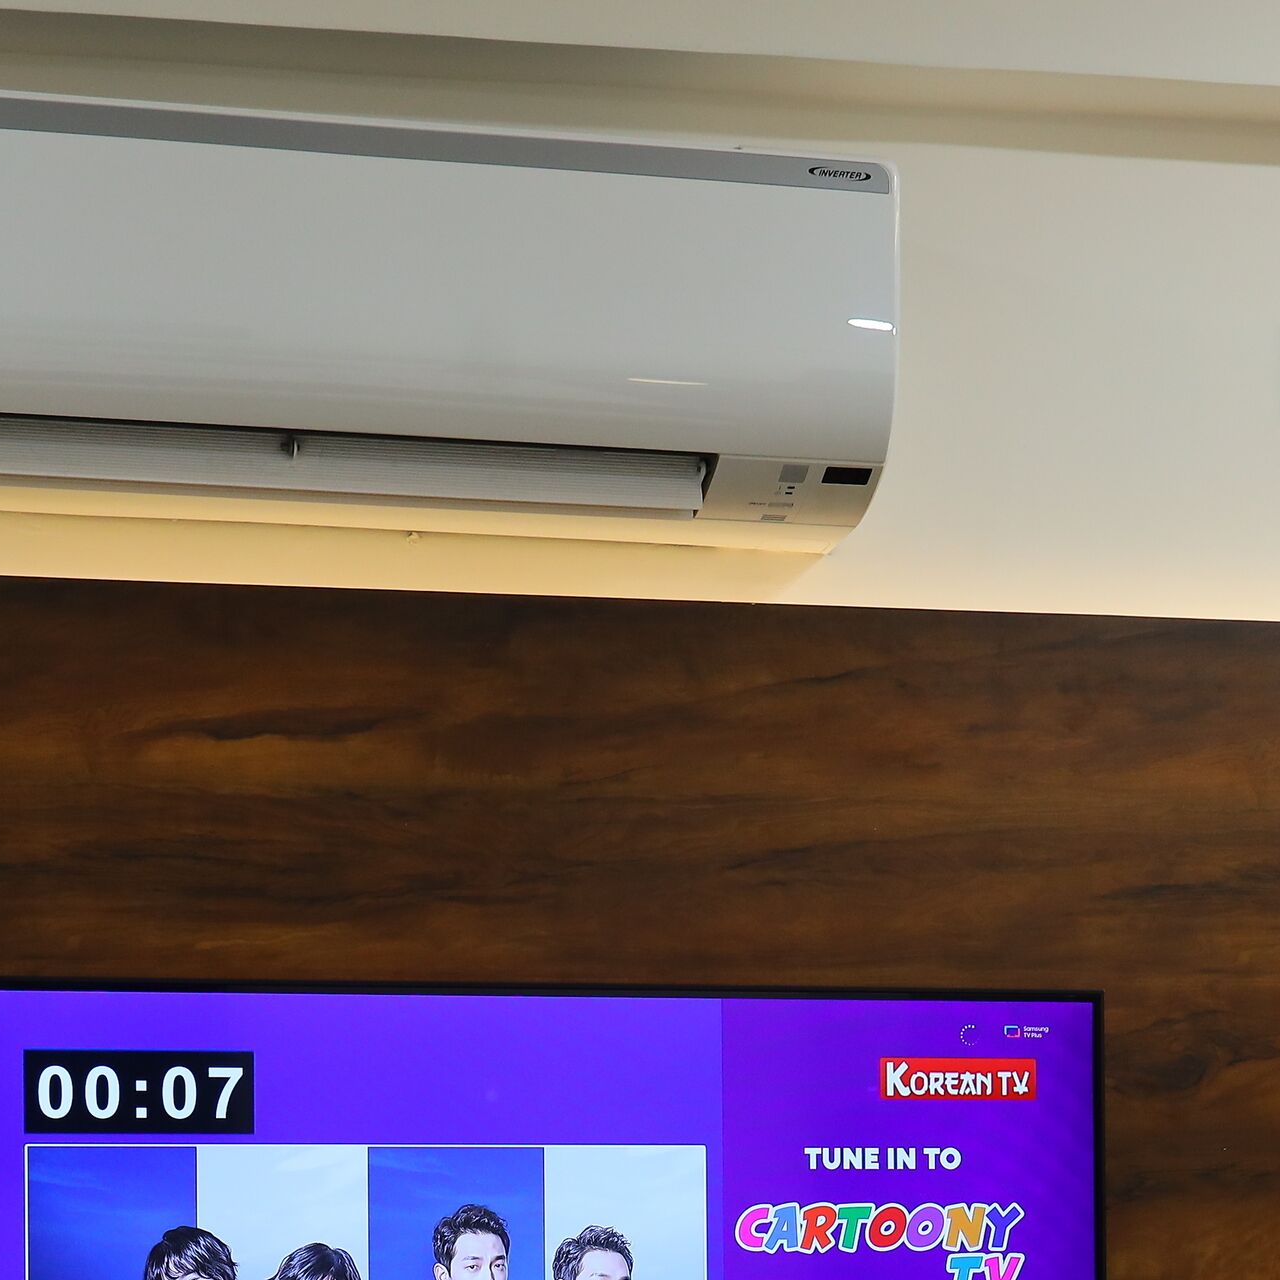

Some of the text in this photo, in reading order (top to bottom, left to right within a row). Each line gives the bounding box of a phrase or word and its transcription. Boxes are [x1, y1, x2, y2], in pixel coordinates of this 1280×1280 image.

[819, 169, 862, 179] INVERTER
[1023, 1025, 1049, 1033] Samsung
[38, 1065, 244, 1120] 00:07
[885, 1061, 1030, 1096] KOREAN TV
[804, 1147, 962, 1170] TUNE IN TO
[735, 1203, 1024, 1253] CARTOONY
